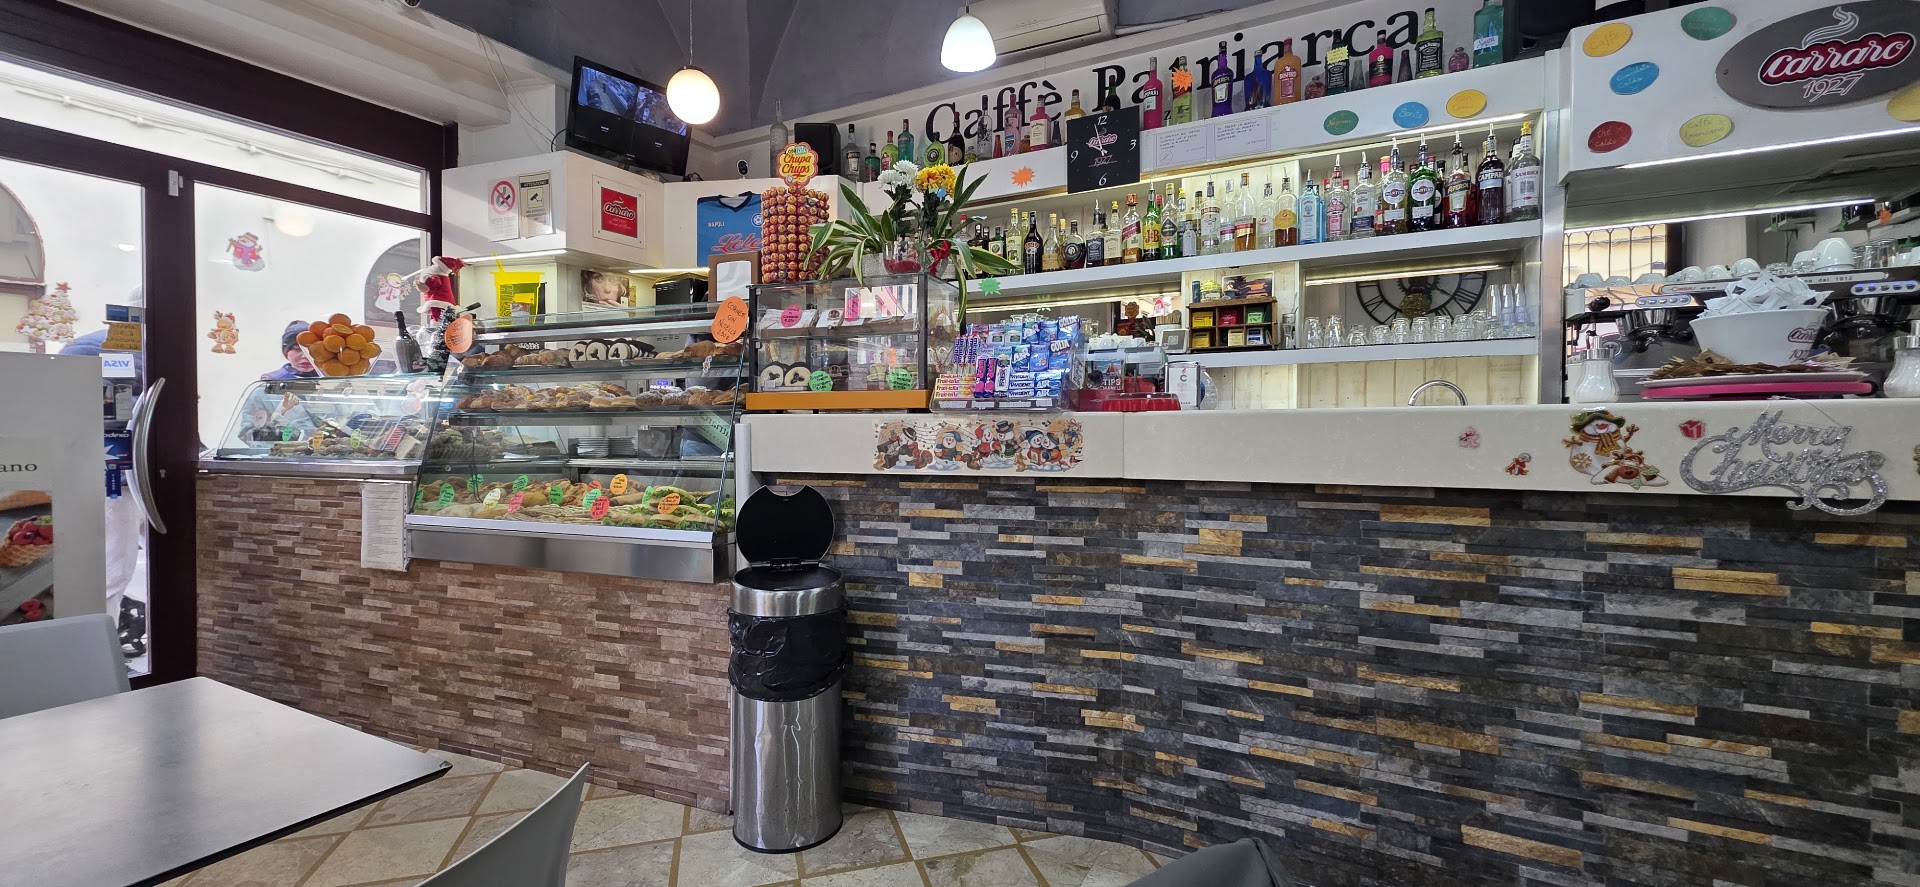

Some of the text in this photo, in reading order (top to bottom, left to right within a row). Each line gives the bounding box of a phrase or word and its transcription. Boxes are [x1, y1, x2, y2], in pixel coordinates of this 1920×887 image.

[1092, 10, 1418, 112] Pariarca
[1802, 72, 1865, 102] 1927
[1097, 115, 1108, 126] 12
[1128, 139, 1137, 151] 3
[783, 153, 812, 165] Chupa
[1070, 150, 1079, 164] 9
[781, 164, 810, 174] Chups
[1098, 172, 1108, 186] 6
[1739, 410, 1853, 464] Merry
